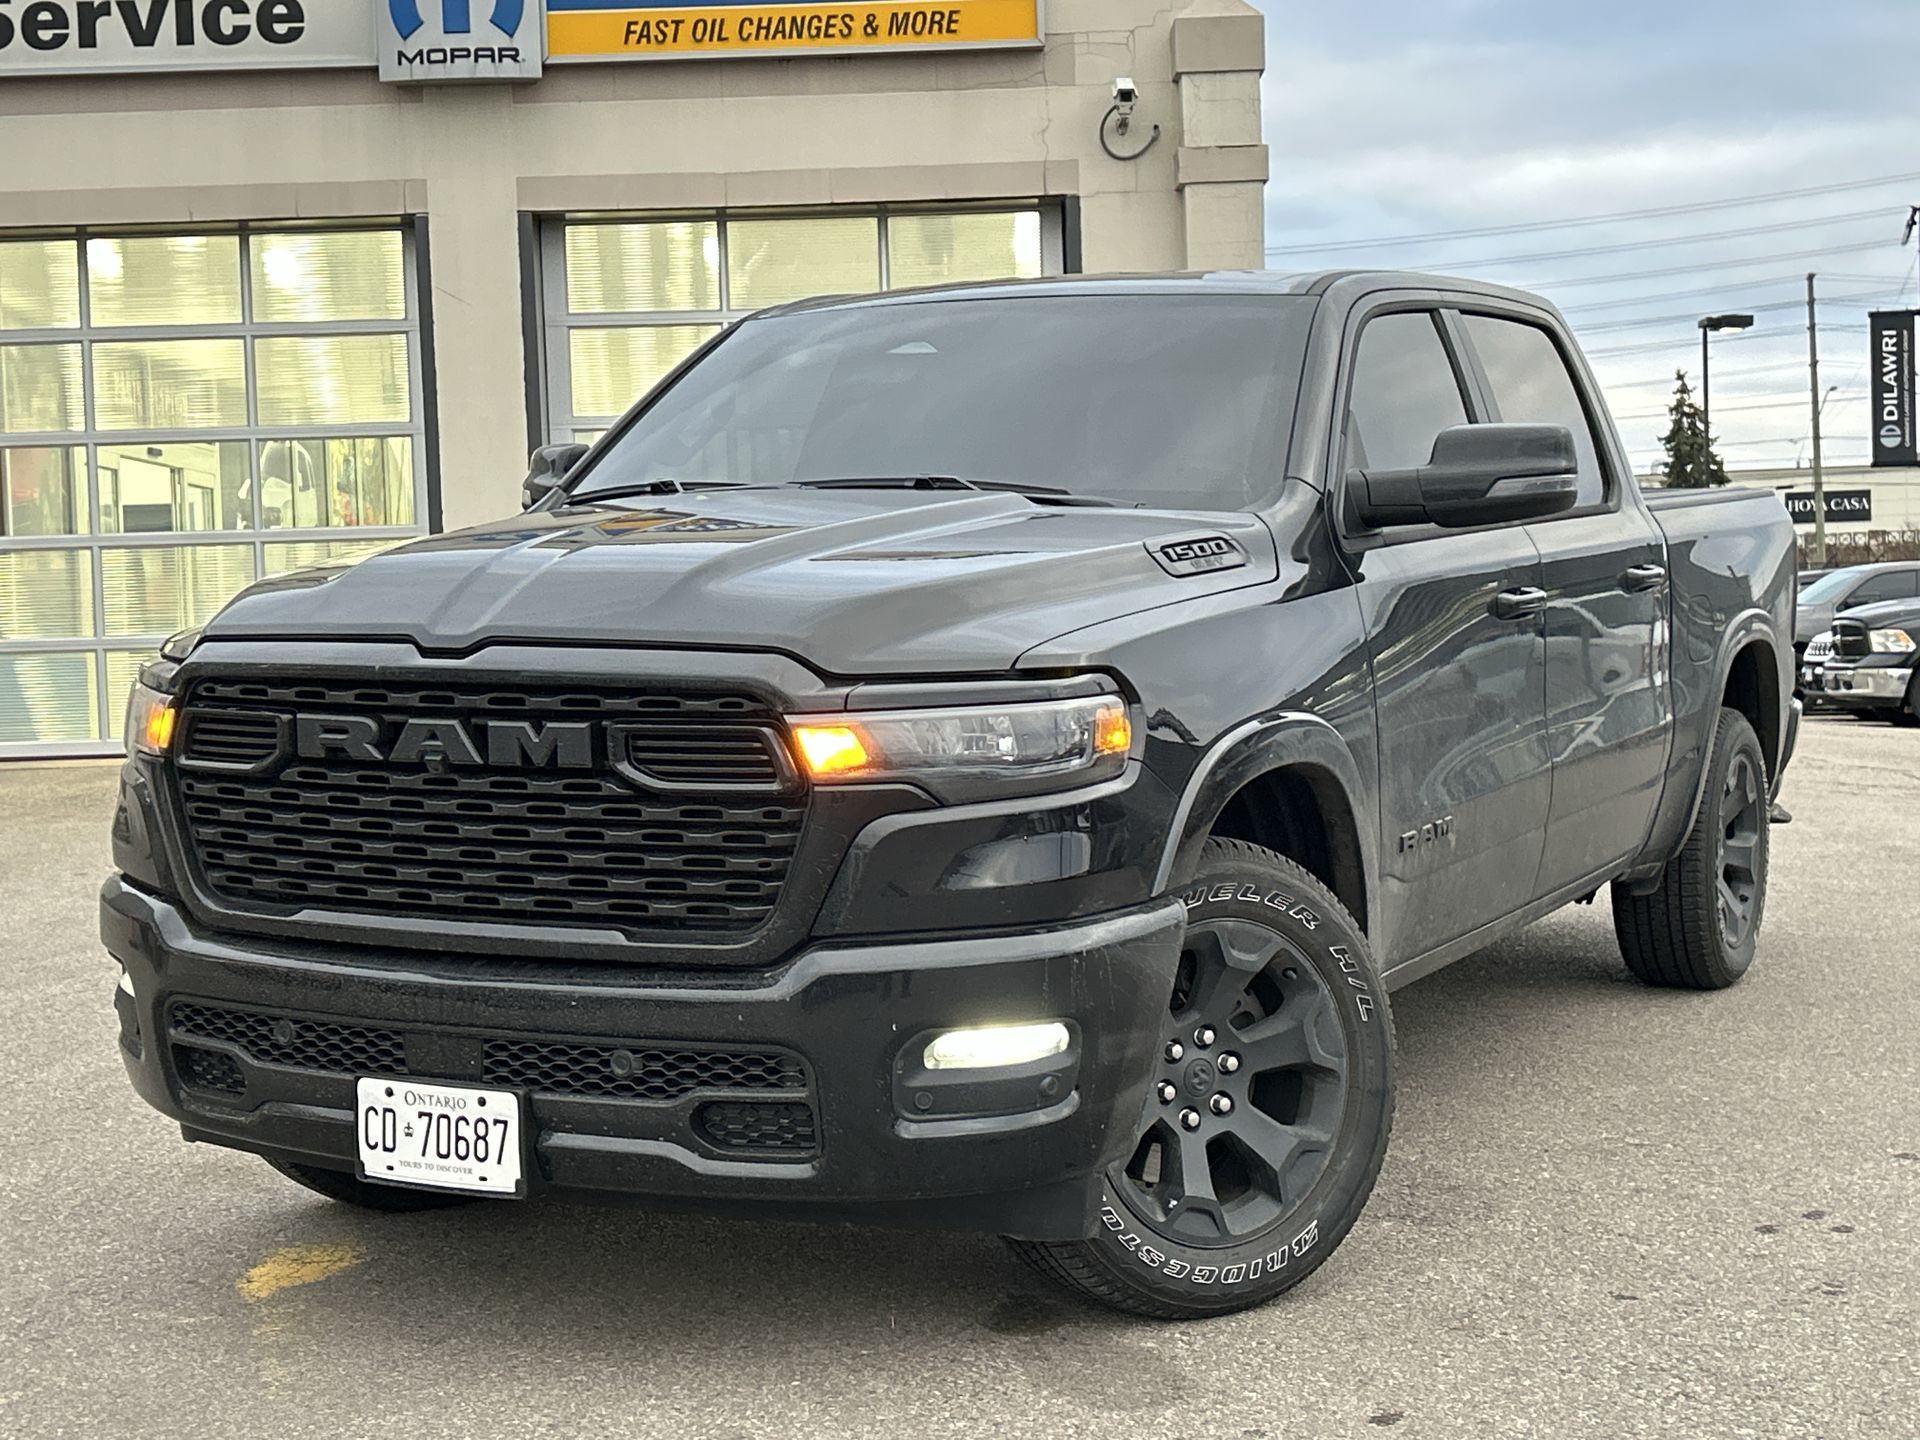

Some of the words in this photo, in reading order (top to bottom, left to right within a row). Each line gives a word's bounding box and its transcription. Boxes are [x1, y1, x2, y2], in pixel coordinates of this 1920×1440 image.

[624, 19, 685, 45] FAST
[692, 17, 729, 43] OIL
[738, 13, 853, 42] CHANGES
[863, 14, 880, 37] &
[887, 10, 960, 36] MORE
[397, 47, 520, 66] MOPAR
[1882, 329, 1899, 422] DILAWRI
[1830, 497, 1870, 512] CASA
[1163, 539, 1229, 561] 1500
[296, 713, 593, 768] RAM
[1398, 815, 1454, 855] RAM
[1182, 882, 1321, 930] UELER
[364, 1105, 397, 1153] CD
[417, 1111, 509, 1165] 70687
[398, 1159, 423, 1169] YOURS
[424, 1162, 435, 1170] TO
[435, 1164, 474, 1175] DISCOVER
[1100, 1198, 1319, 1284] BRIDGESTO
